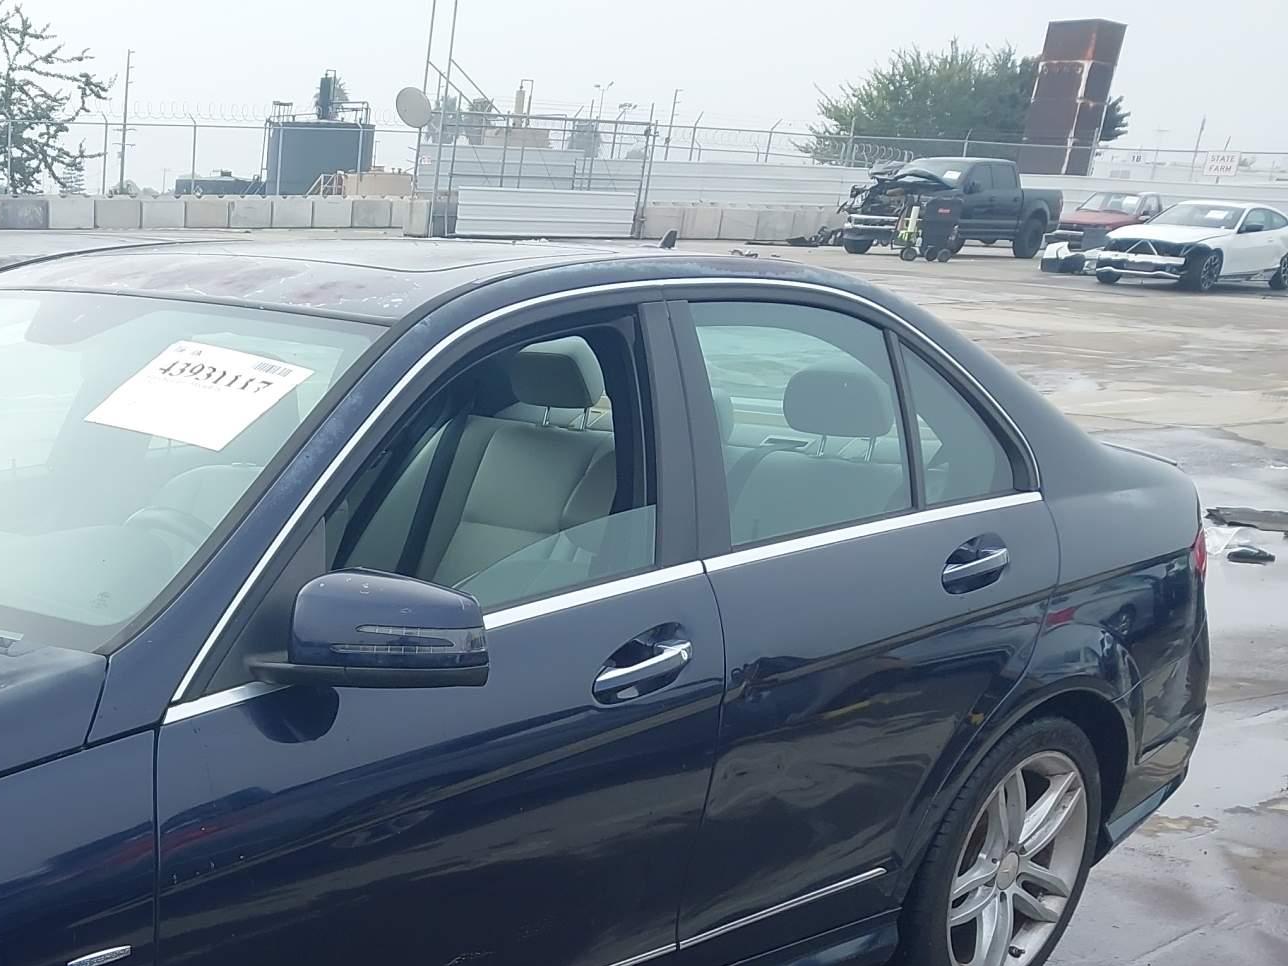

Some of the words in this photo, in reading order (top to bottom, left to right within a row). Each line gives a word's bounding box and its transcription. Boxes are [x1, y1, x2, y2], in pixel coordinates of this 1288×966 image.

[1210, 154, 1235, 163] STATE
[1208, 164, 1232, 173] FARM
[158, 360, 274, 393] 43931117
